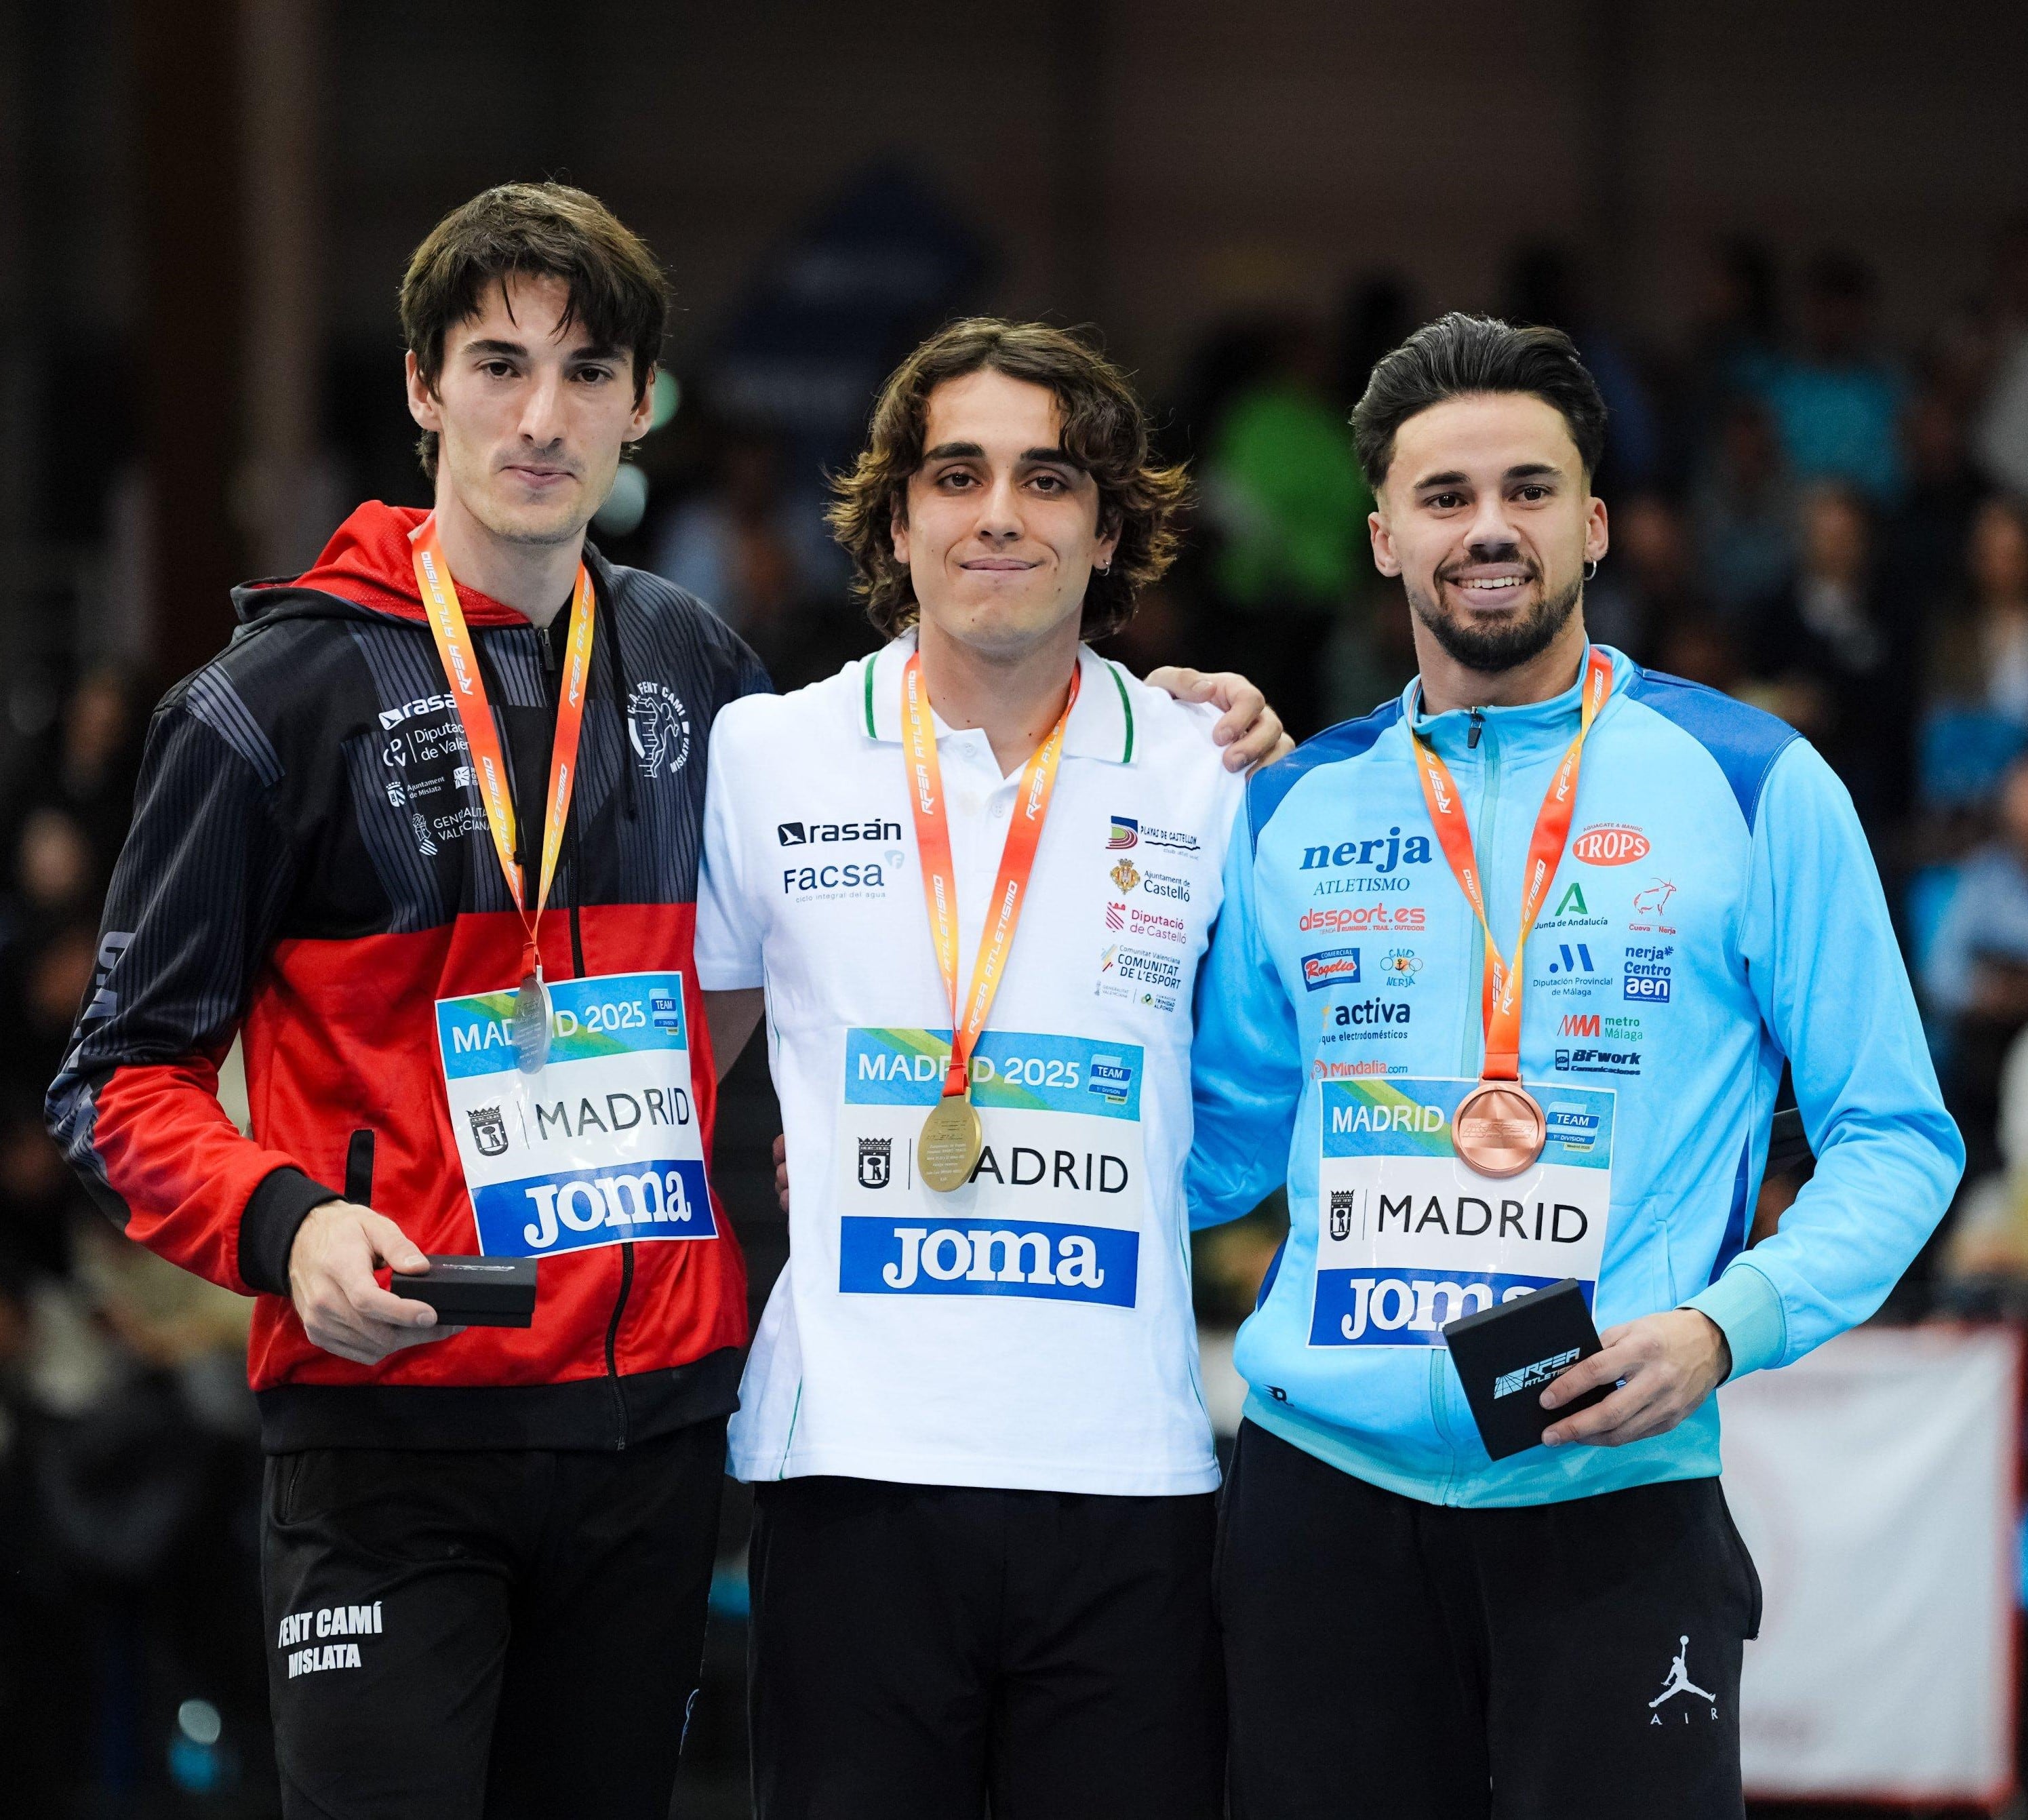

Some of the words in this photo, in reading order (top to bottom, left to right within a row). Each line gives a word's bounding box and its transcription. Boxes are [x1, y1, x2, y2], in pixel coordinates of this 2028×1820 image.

[637, 681, 658, 695] FENT
[402, 691, 458, 718] rasá
[414, 722, 465, 743] Diputac
[420, 747, 439, 761] de
[669, 738, 690, 773] MISLATA
[407, 776, 445, 791] Ajuntament
[418, 786, 441, 797] Mislata
[810, 818, 901, 844] rasán
[1583, 823, 1614, 833] AGUACATE
[1621, 823, 1643, 833] MANGO
[1299, 827, 1432, 873] nerja
[1576, 831, 1646, 859] TROPS
[1144, 871, 1182, 885] Ajuntament
[1183, 879, 1191, 888] de
[1313, 877, 1410, 895] ATLETISMO
[816, 892, 846, 901] integral
[849, 890, 862, 898] del
[865, 891, 886, 900] agua
[1144, 880, 1190, 902] Castelló
[1131, 909, 1184, 930] Diputació
[1535, 919, 1555, 930] Junta
[1557, 919, 1566, 927] de
[1568, 917, 1608, 926] Andalucía
[1130, 923, 1145, 934] de
[1147, 926, 1187, 944] Castelló
[1119, 945, 1151, 957] Comunitat
[1321, 949, 1353, 959] COMERCIAL
[1118, 953, 1179, 976] COMUNITAT
[1120, 966, 1135, 978] DE
[1624, 961, 1671, 976] Centro
[1387, 976, 1416, 987] NERJA
[1533, 977, 1573, 987] Diputación
[1575, 976, 1613, 985] Provincial
[1626, 978, 1668, 997] aen
[1562, 988, 1591, 997] Málaga
[655, 1000, 673, 1010] TEAM
[1335, 997, 1410, 1026] activa
[584, 1001, 645, 1034] 2025
[1605, 1016, 1639, 1027] metro
[1321, 1035, 1336, 1045] que
[1338, 1029, 1408, 1042] electrodomésticos
[1605, 1028, 1643, 1042] Málaga
[1572, 1049, 1642, 1065] BFwork
[1003, 1057, 1079, 1088] 2025
[1098, 1067, 1123, 1079] TEAM
[1330, 1060, 1408, 1077] Mindalia.com
[1571, 1065, 1641, 1075] Comunicaciones
[535, 1088, 689, 1141] MADRID
[1331, 1105, 1445, 1134] MADRID
[1556, 1114, 1589, 1126] TEAM
[968, 1145, 1128, 1194] ADRID
[1378, 1194, 1588, 1244] MADRID
[1341, 1278, 1538, 1340] Jom
[1524, 1347, 1580, 1379] RFEA
[316, 1601, 382, 1638] CAMÍ
[288, 1644, 361, 1679] MISLATA
[1650, 1707, 1718, 1725] AIR
